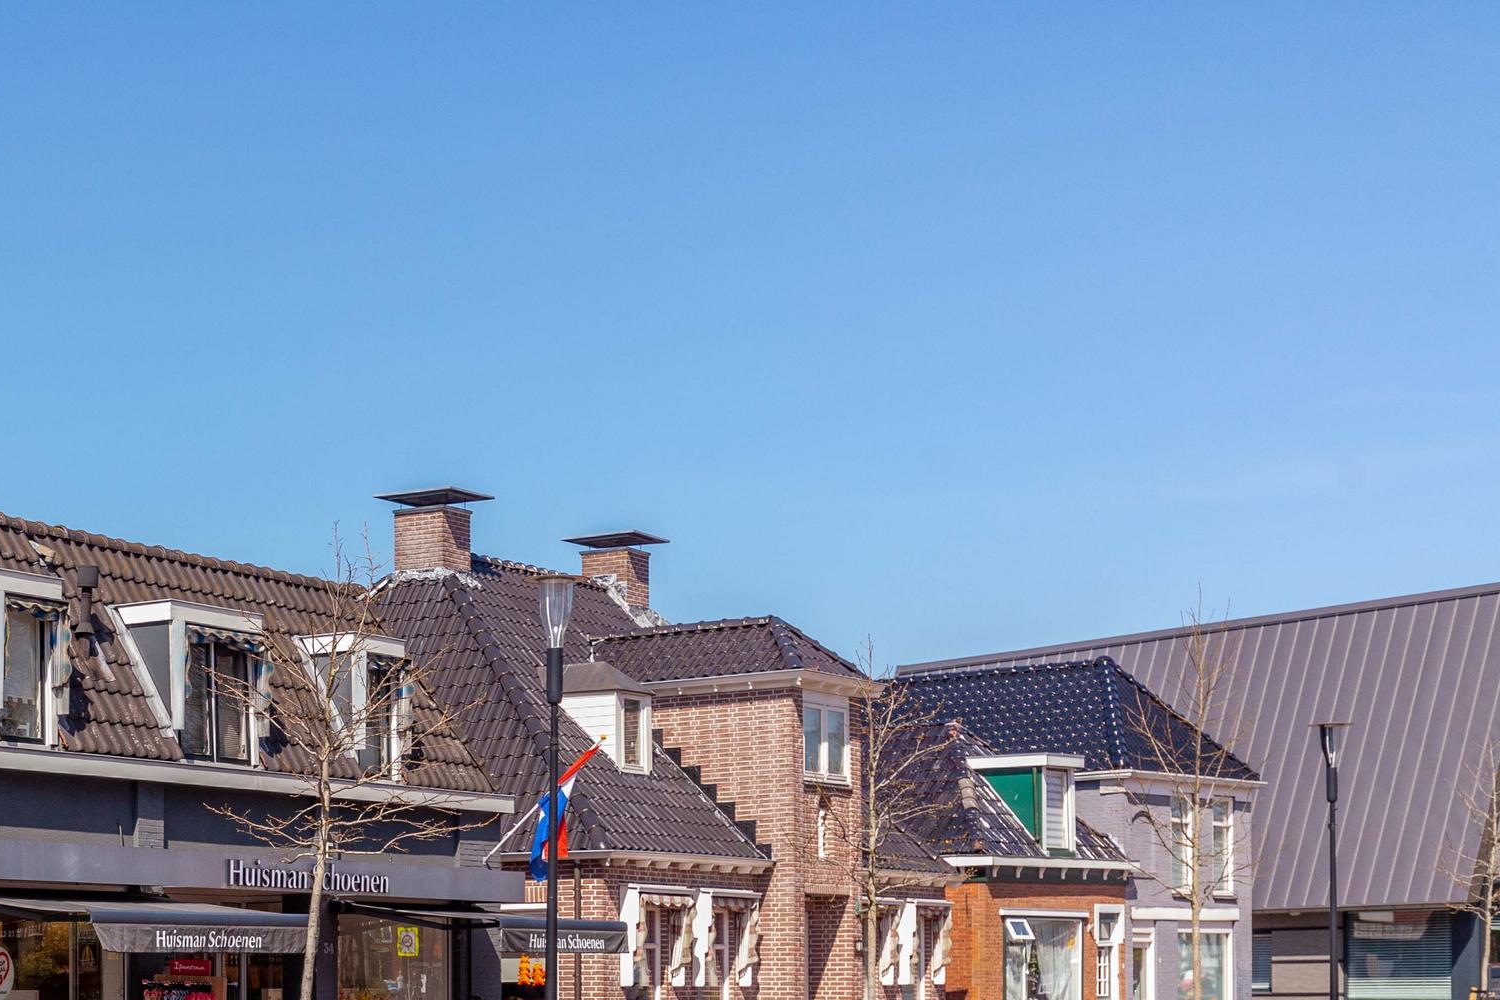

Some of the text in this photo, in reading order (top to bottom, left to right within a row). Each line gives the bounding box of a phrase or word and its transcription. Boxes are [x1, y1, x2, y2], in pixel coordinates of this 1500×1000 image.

[229, 859, 308, 889] Huisman
[156, 929, 262, 949] Huisman Schoenen
[323, 943, 334, 954] 34
[529, 932, 605, 950] Huian Schoenen
